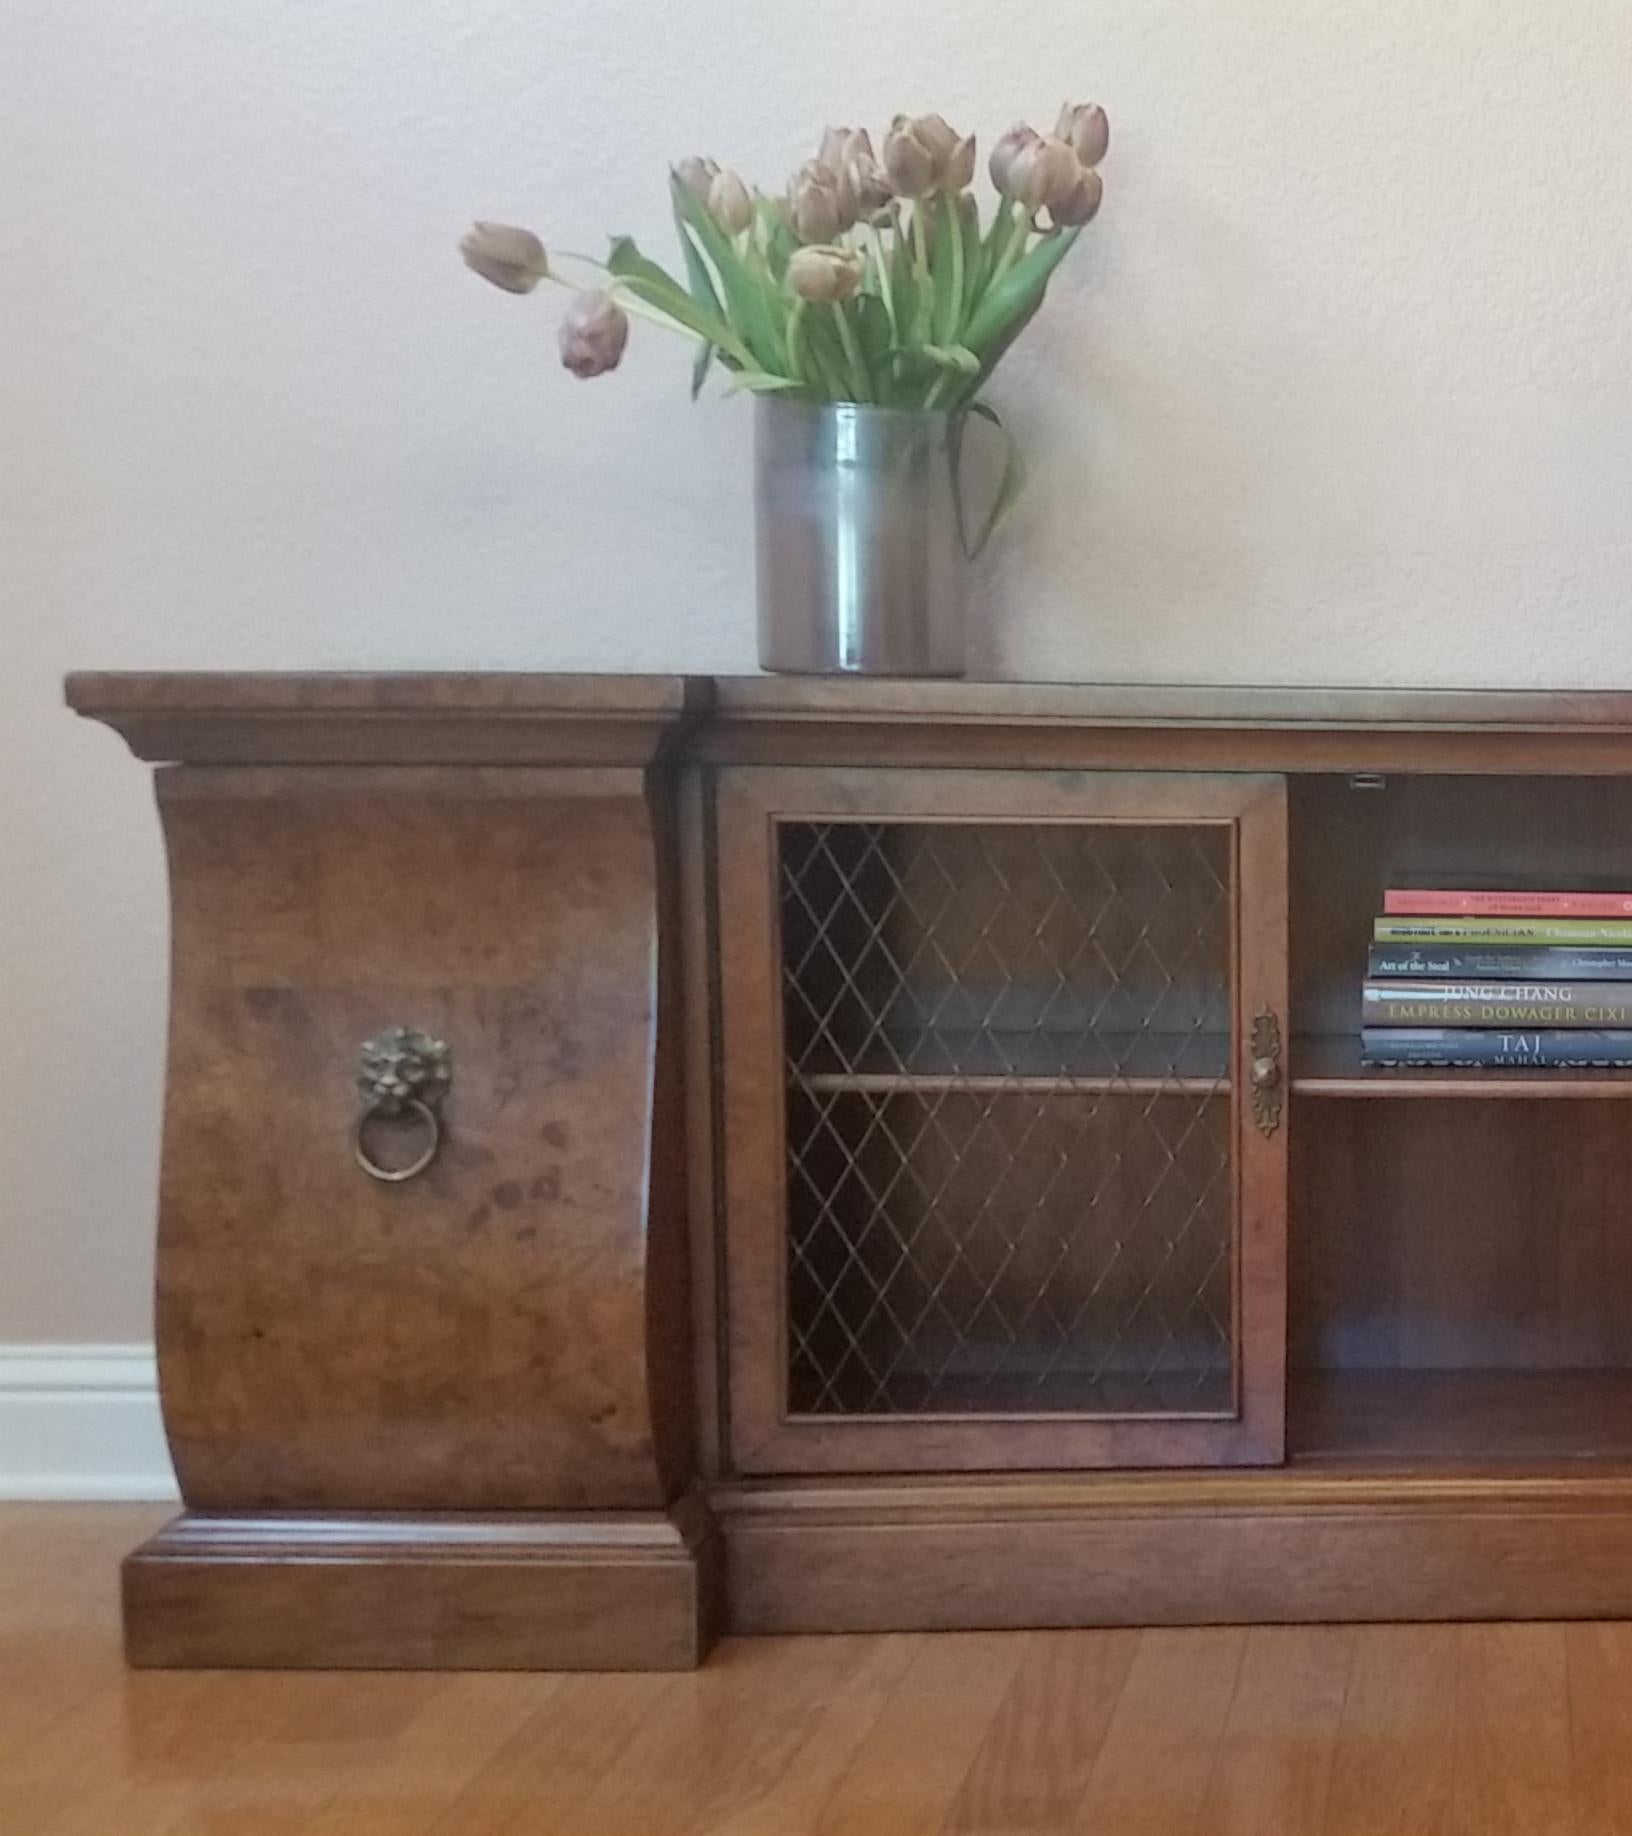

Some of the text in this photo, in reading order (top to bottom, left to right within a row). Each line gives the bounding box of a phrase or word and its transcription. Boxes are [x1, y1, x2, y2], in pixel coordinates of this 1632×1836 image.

[1379, 960, 1450, 971] Art of the Steal
[1572, 958, 1616, 969] Christopher
[1443, 986, 1572, 1002] JUNG CHANG
[1389, 1005, 1625, 1021] EMPRESS DOWAGER CIXI
[1498, 1034, 1541, 1053] TAJ
